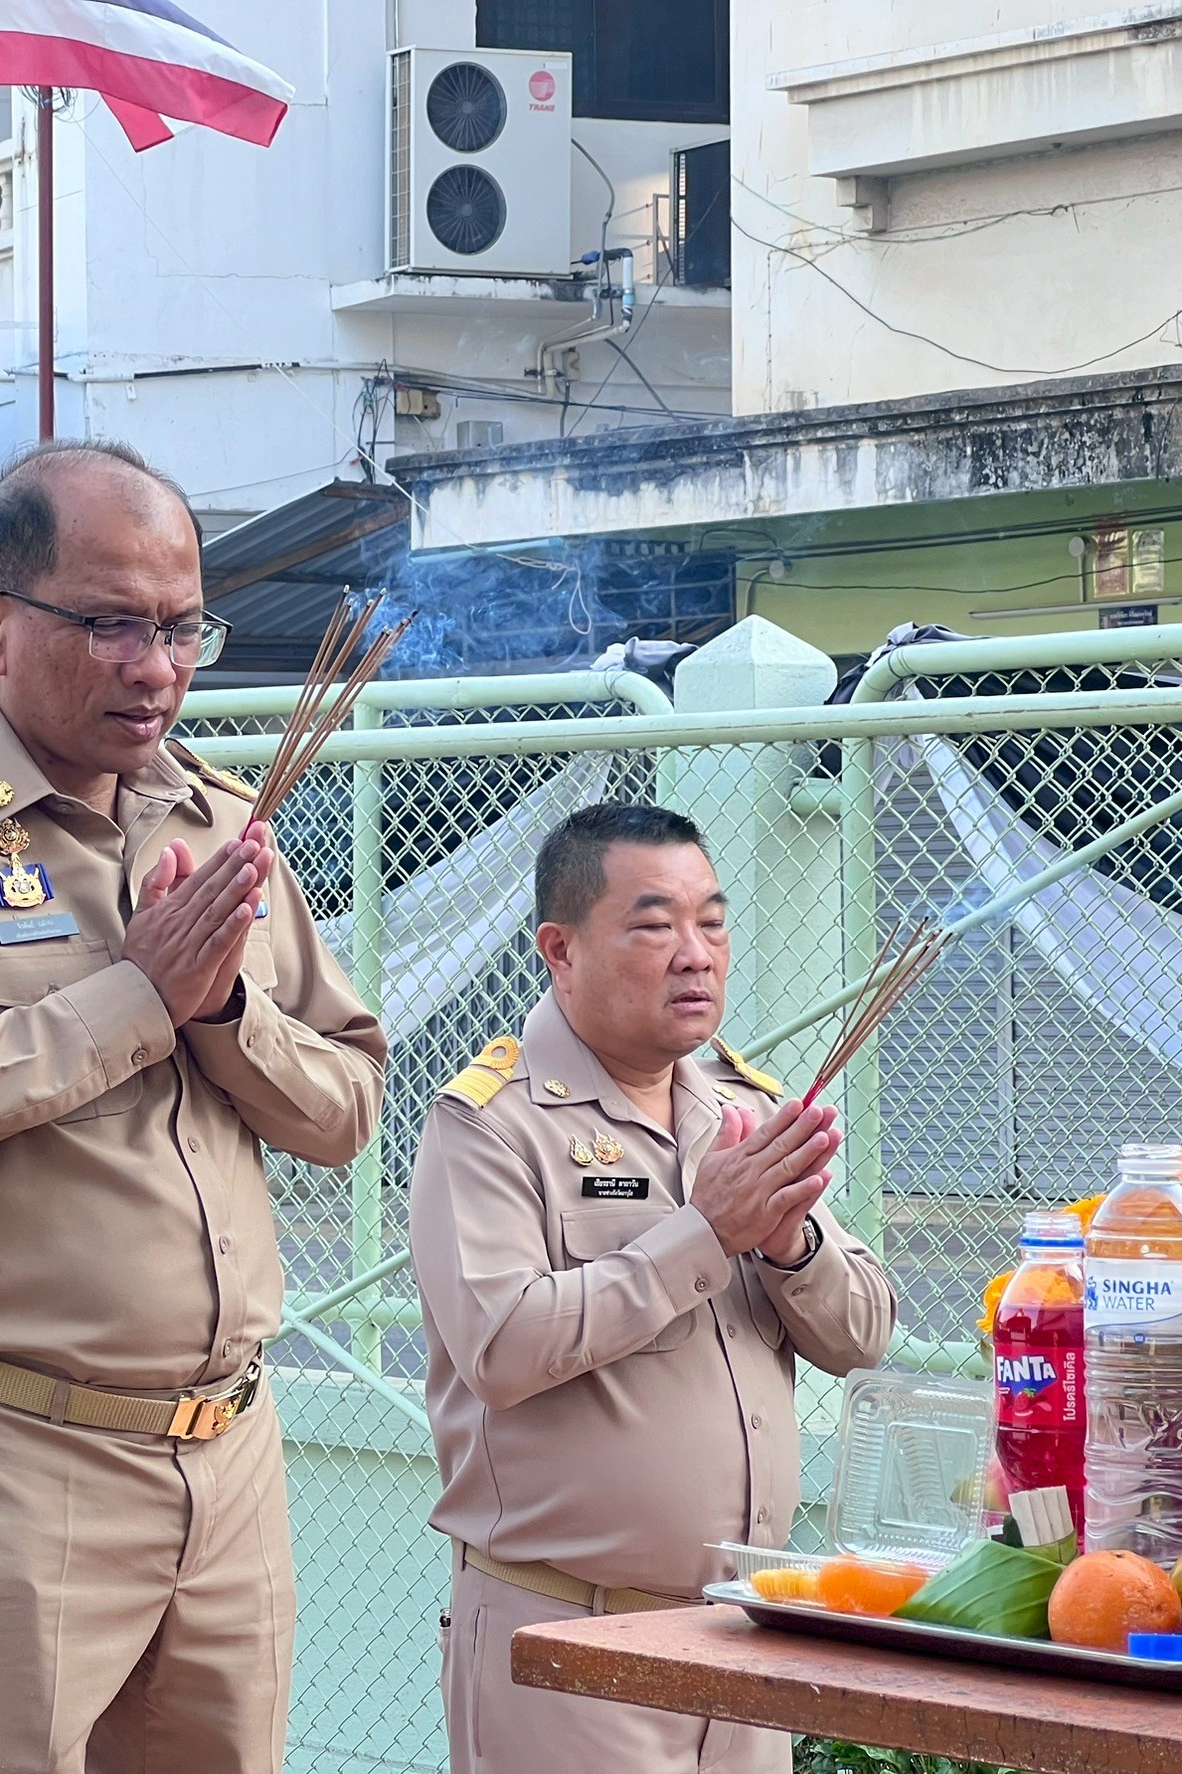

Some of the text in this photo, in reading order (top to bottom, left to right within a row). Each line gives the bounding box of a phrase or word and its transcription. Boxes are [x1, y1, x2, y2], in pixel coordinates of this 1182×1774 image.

[1102, 1278, 1171, 1296] SINGHA
[1103, 1295, 1156, 1311] WATER
[996, 1355, 1056, 1383] FANTA
[1063, 1352, 1076, 1422] โปรดรีไซเคิล
